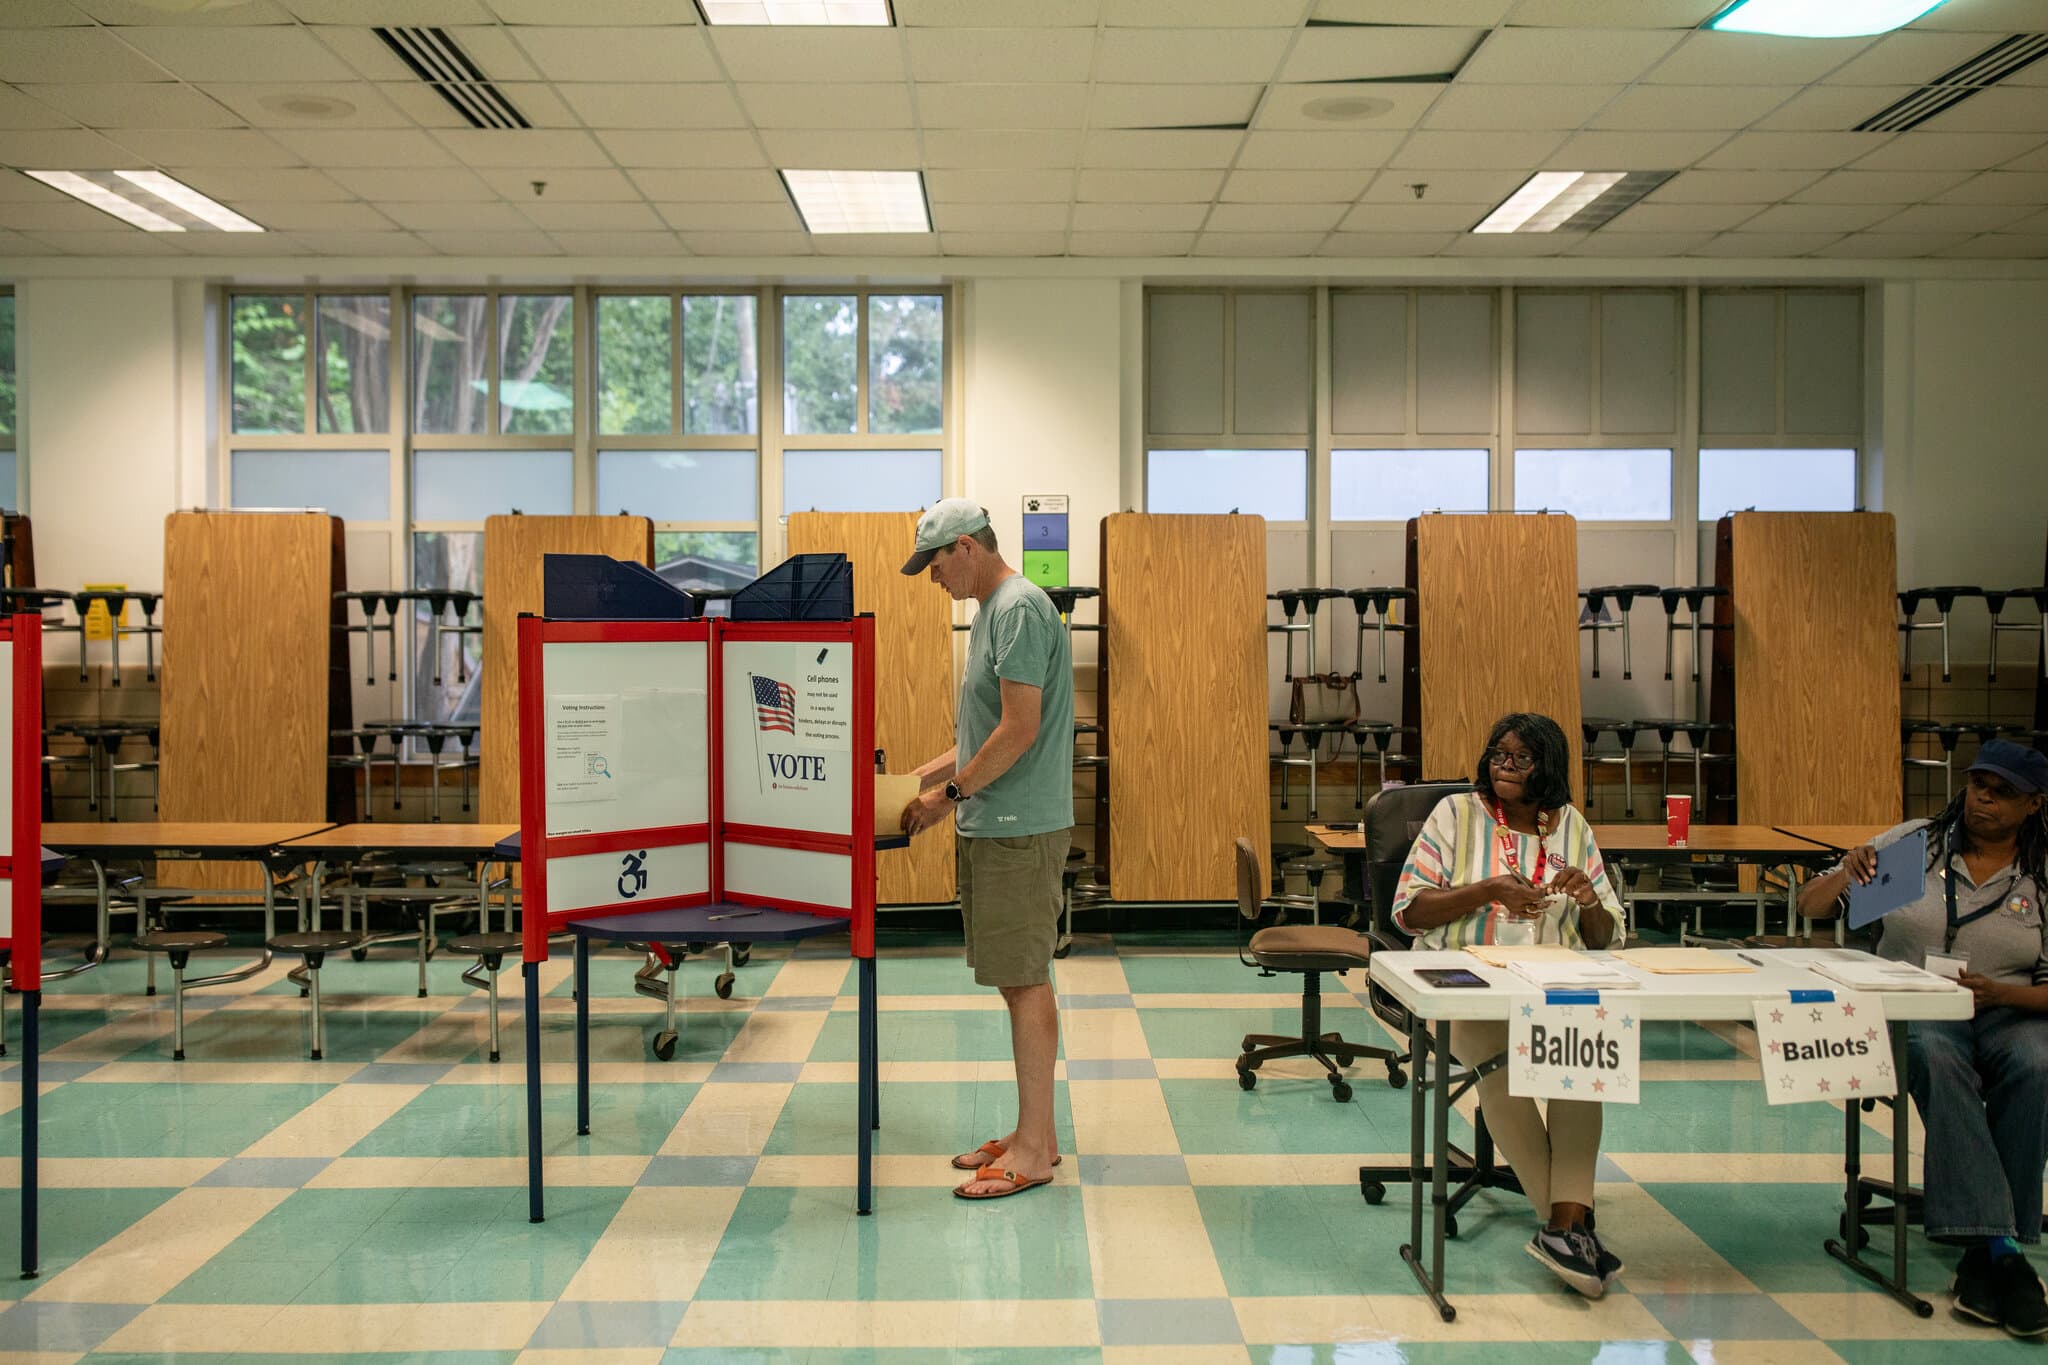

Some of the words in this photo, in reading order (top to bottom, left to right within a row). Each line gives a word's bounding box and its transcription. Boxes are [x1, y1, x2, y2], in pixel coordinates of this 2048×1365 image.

[1041, 526, 1049, 537] 3
[1042, 564, 1050, 575] 2
[818, 675, 839, 684] phones
[767, 753, 826, 781] VOTE
[1531, 1024, 1620, 1070] Ballots
[1782, 1037, 1869, 1062] Ballots
